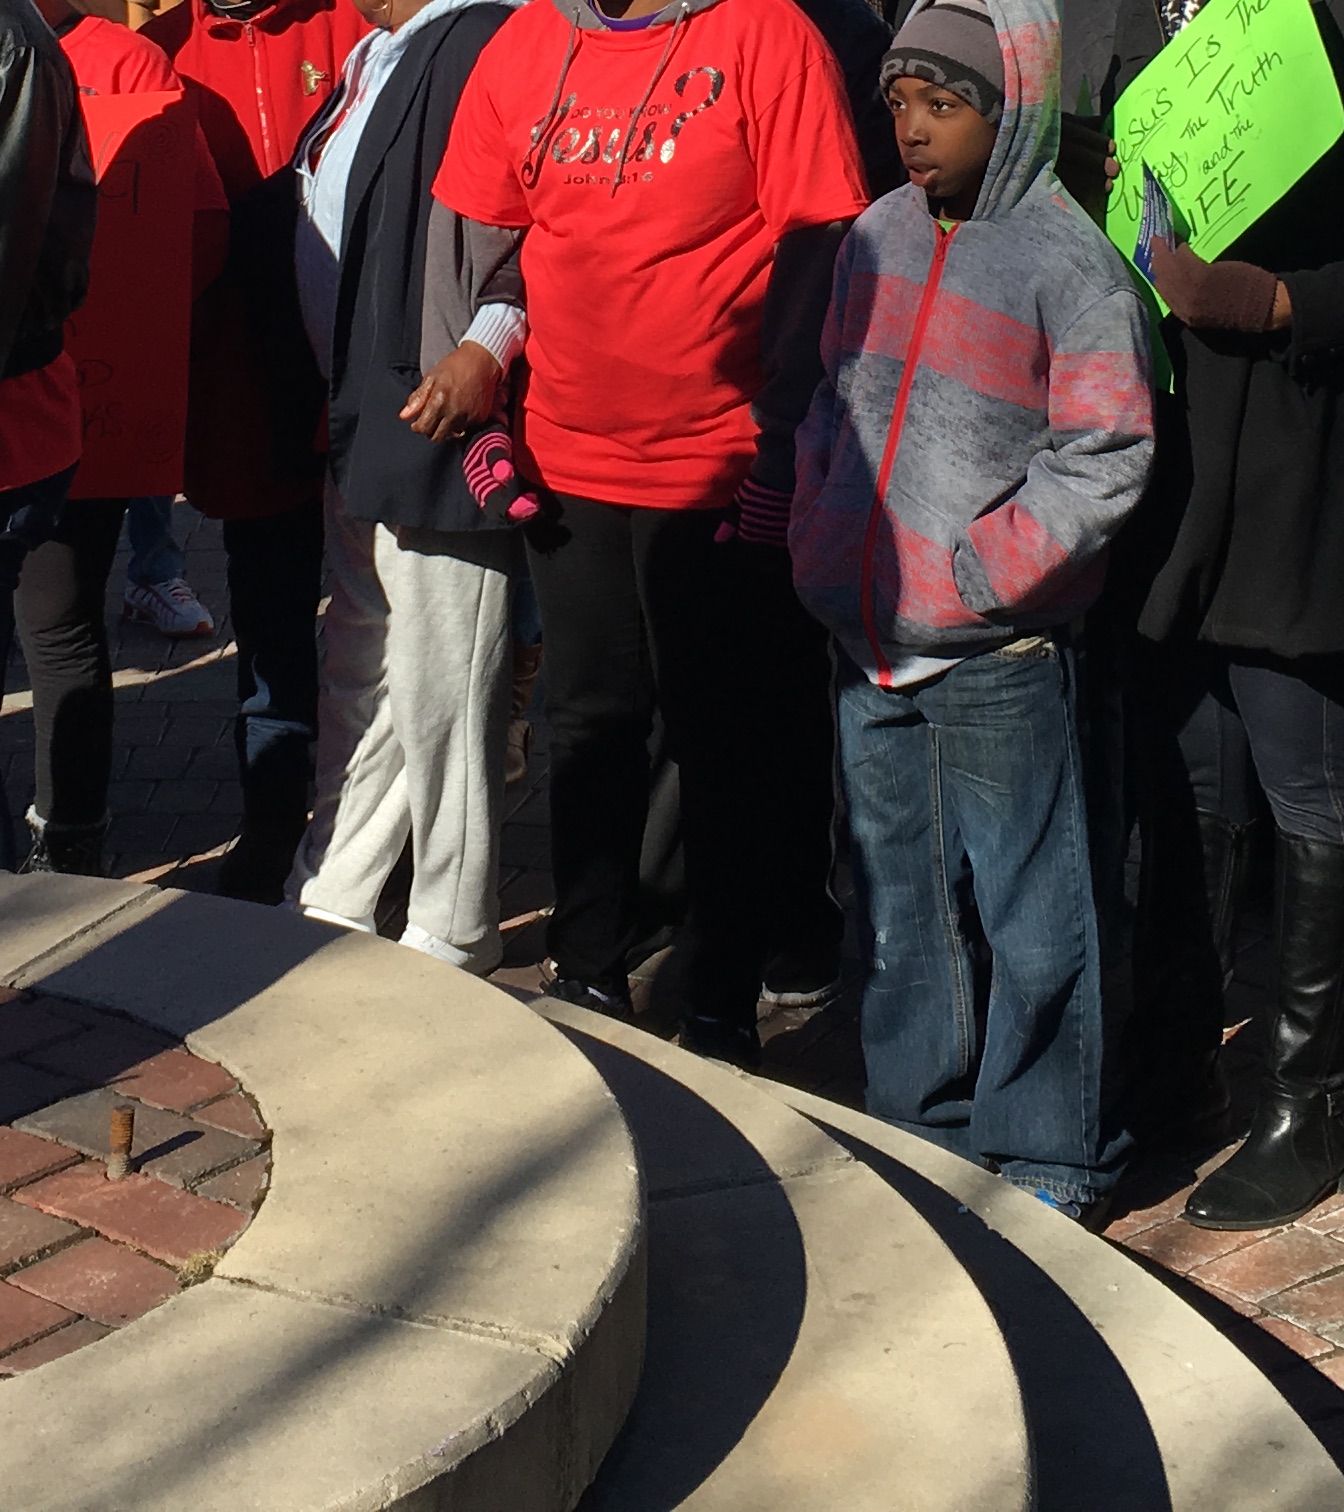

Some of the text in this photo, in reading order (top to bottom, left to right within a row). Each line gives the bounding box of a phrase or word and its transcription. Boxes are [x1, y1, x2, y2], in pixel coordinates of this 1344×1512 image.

[1206, 51, 1283, 116] Truth
[570, 107, 592, 119] DO
[596, 106, 625, 120] YOU
[1202, 134, 1233, 175] and
[563, 172, 611, 185] John
[1187, 149, 1252, 237] IFE
